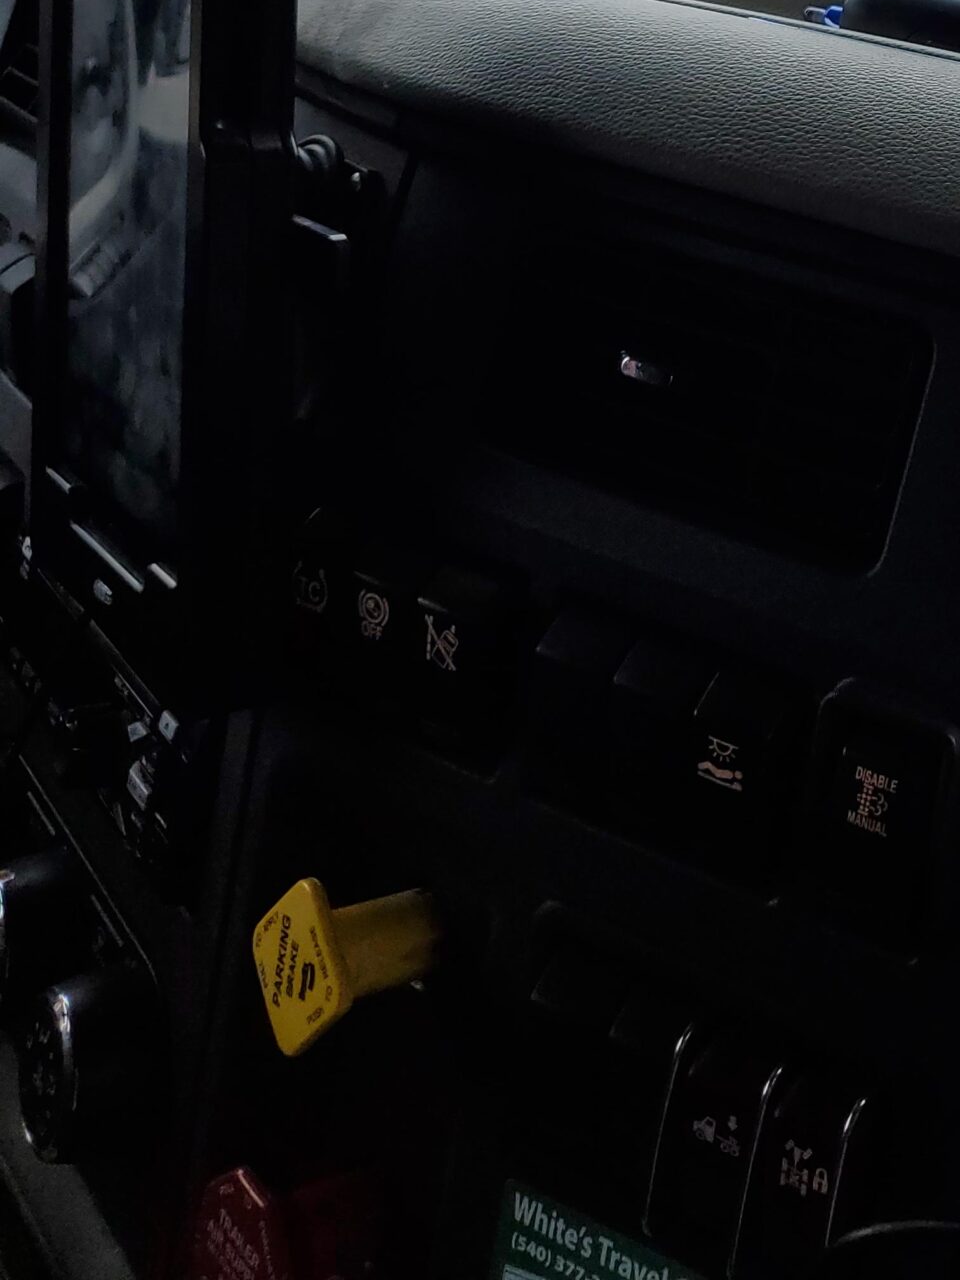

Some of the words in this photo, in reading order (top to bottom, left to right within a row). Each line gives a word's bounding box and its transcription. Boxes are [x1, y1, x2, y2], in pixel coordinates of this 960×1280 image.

[361, 619, 383, 640] OFF
[855, 765, 898, 794] DISABLE
[846, 809, 888, 837] MANUAL
[272, 915, 291, 1008] PARKING
[285, 939, 299, 998] BRAKE
[513, 1192, 593, 1259] White's
[511, 1231, 551, 1267] (540)
